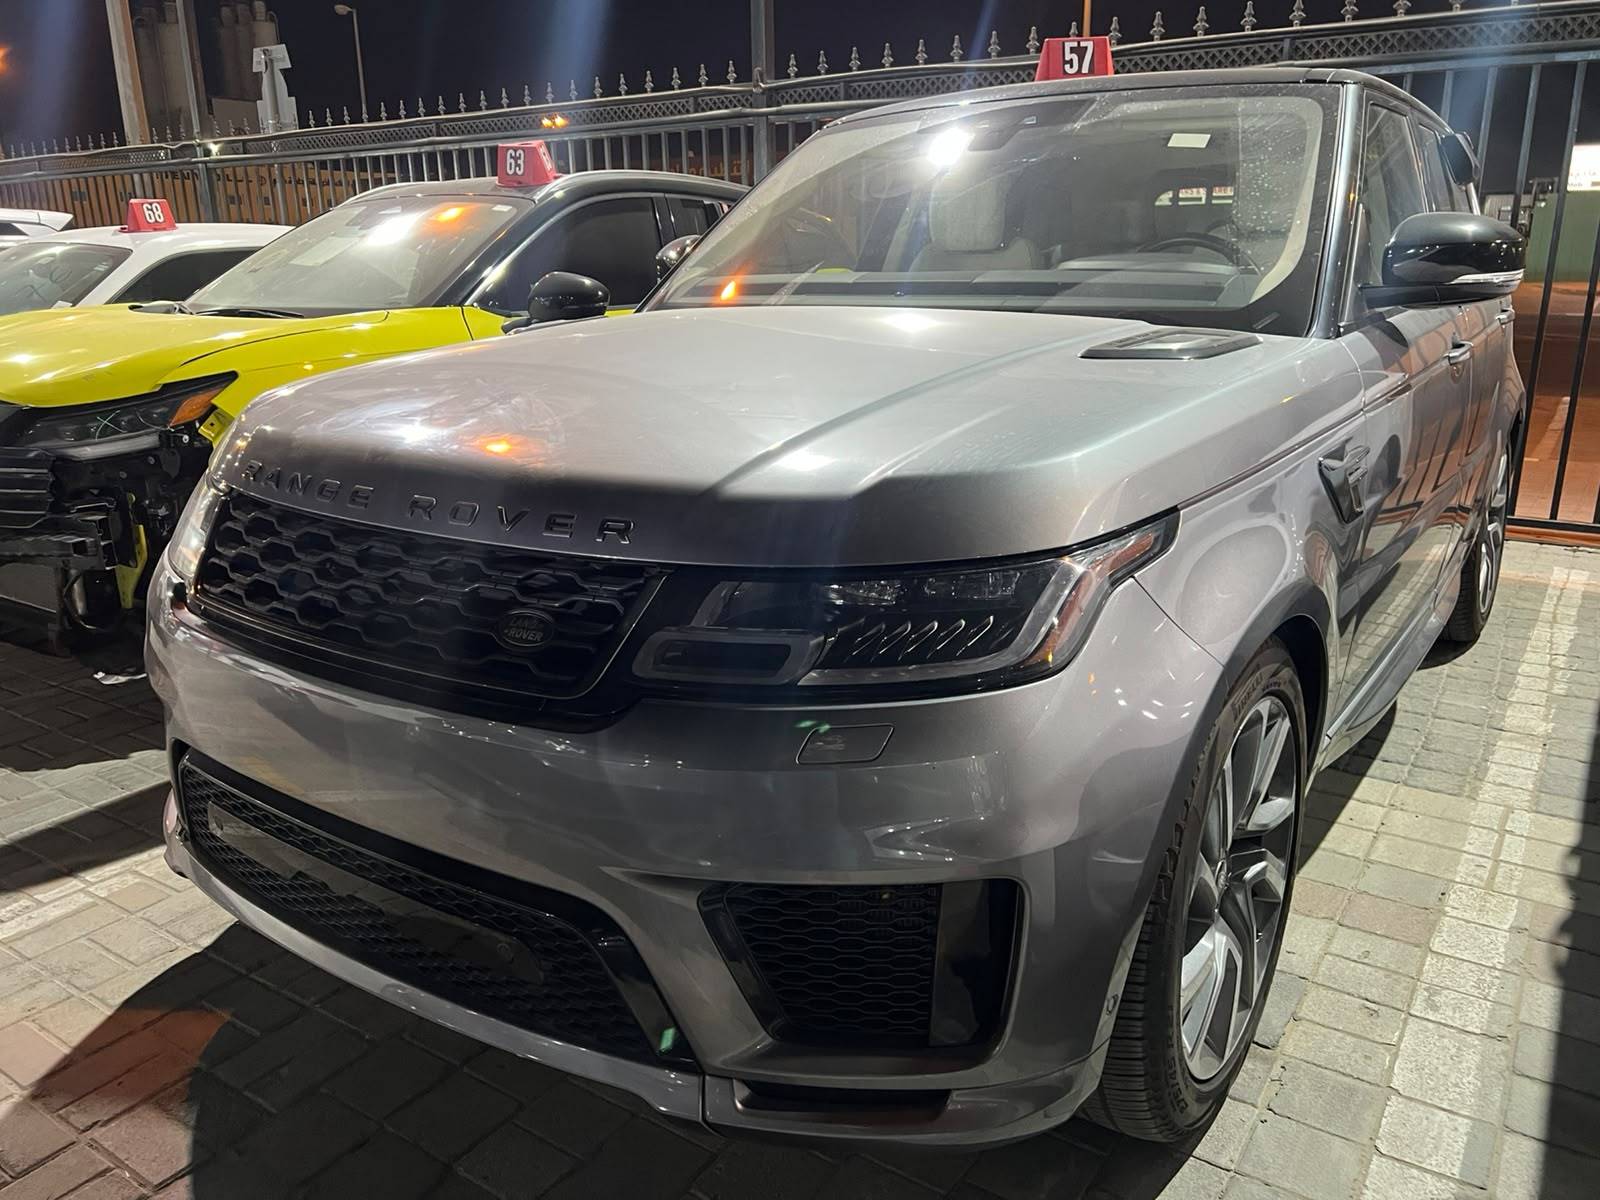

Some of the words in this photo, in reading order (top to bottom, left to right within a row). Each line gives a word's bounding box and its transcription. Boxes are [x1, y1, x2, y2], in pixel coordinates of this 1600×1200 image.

[1064, 40, 1094, 75] 57
[506, 149, 525, 175] 63
[142, 202, 165, 224] 68
[242, 459, 375, 509] RANGE
[407, 494, 635, 544] ROVER
[508, 627, 544, 641] ROVER
